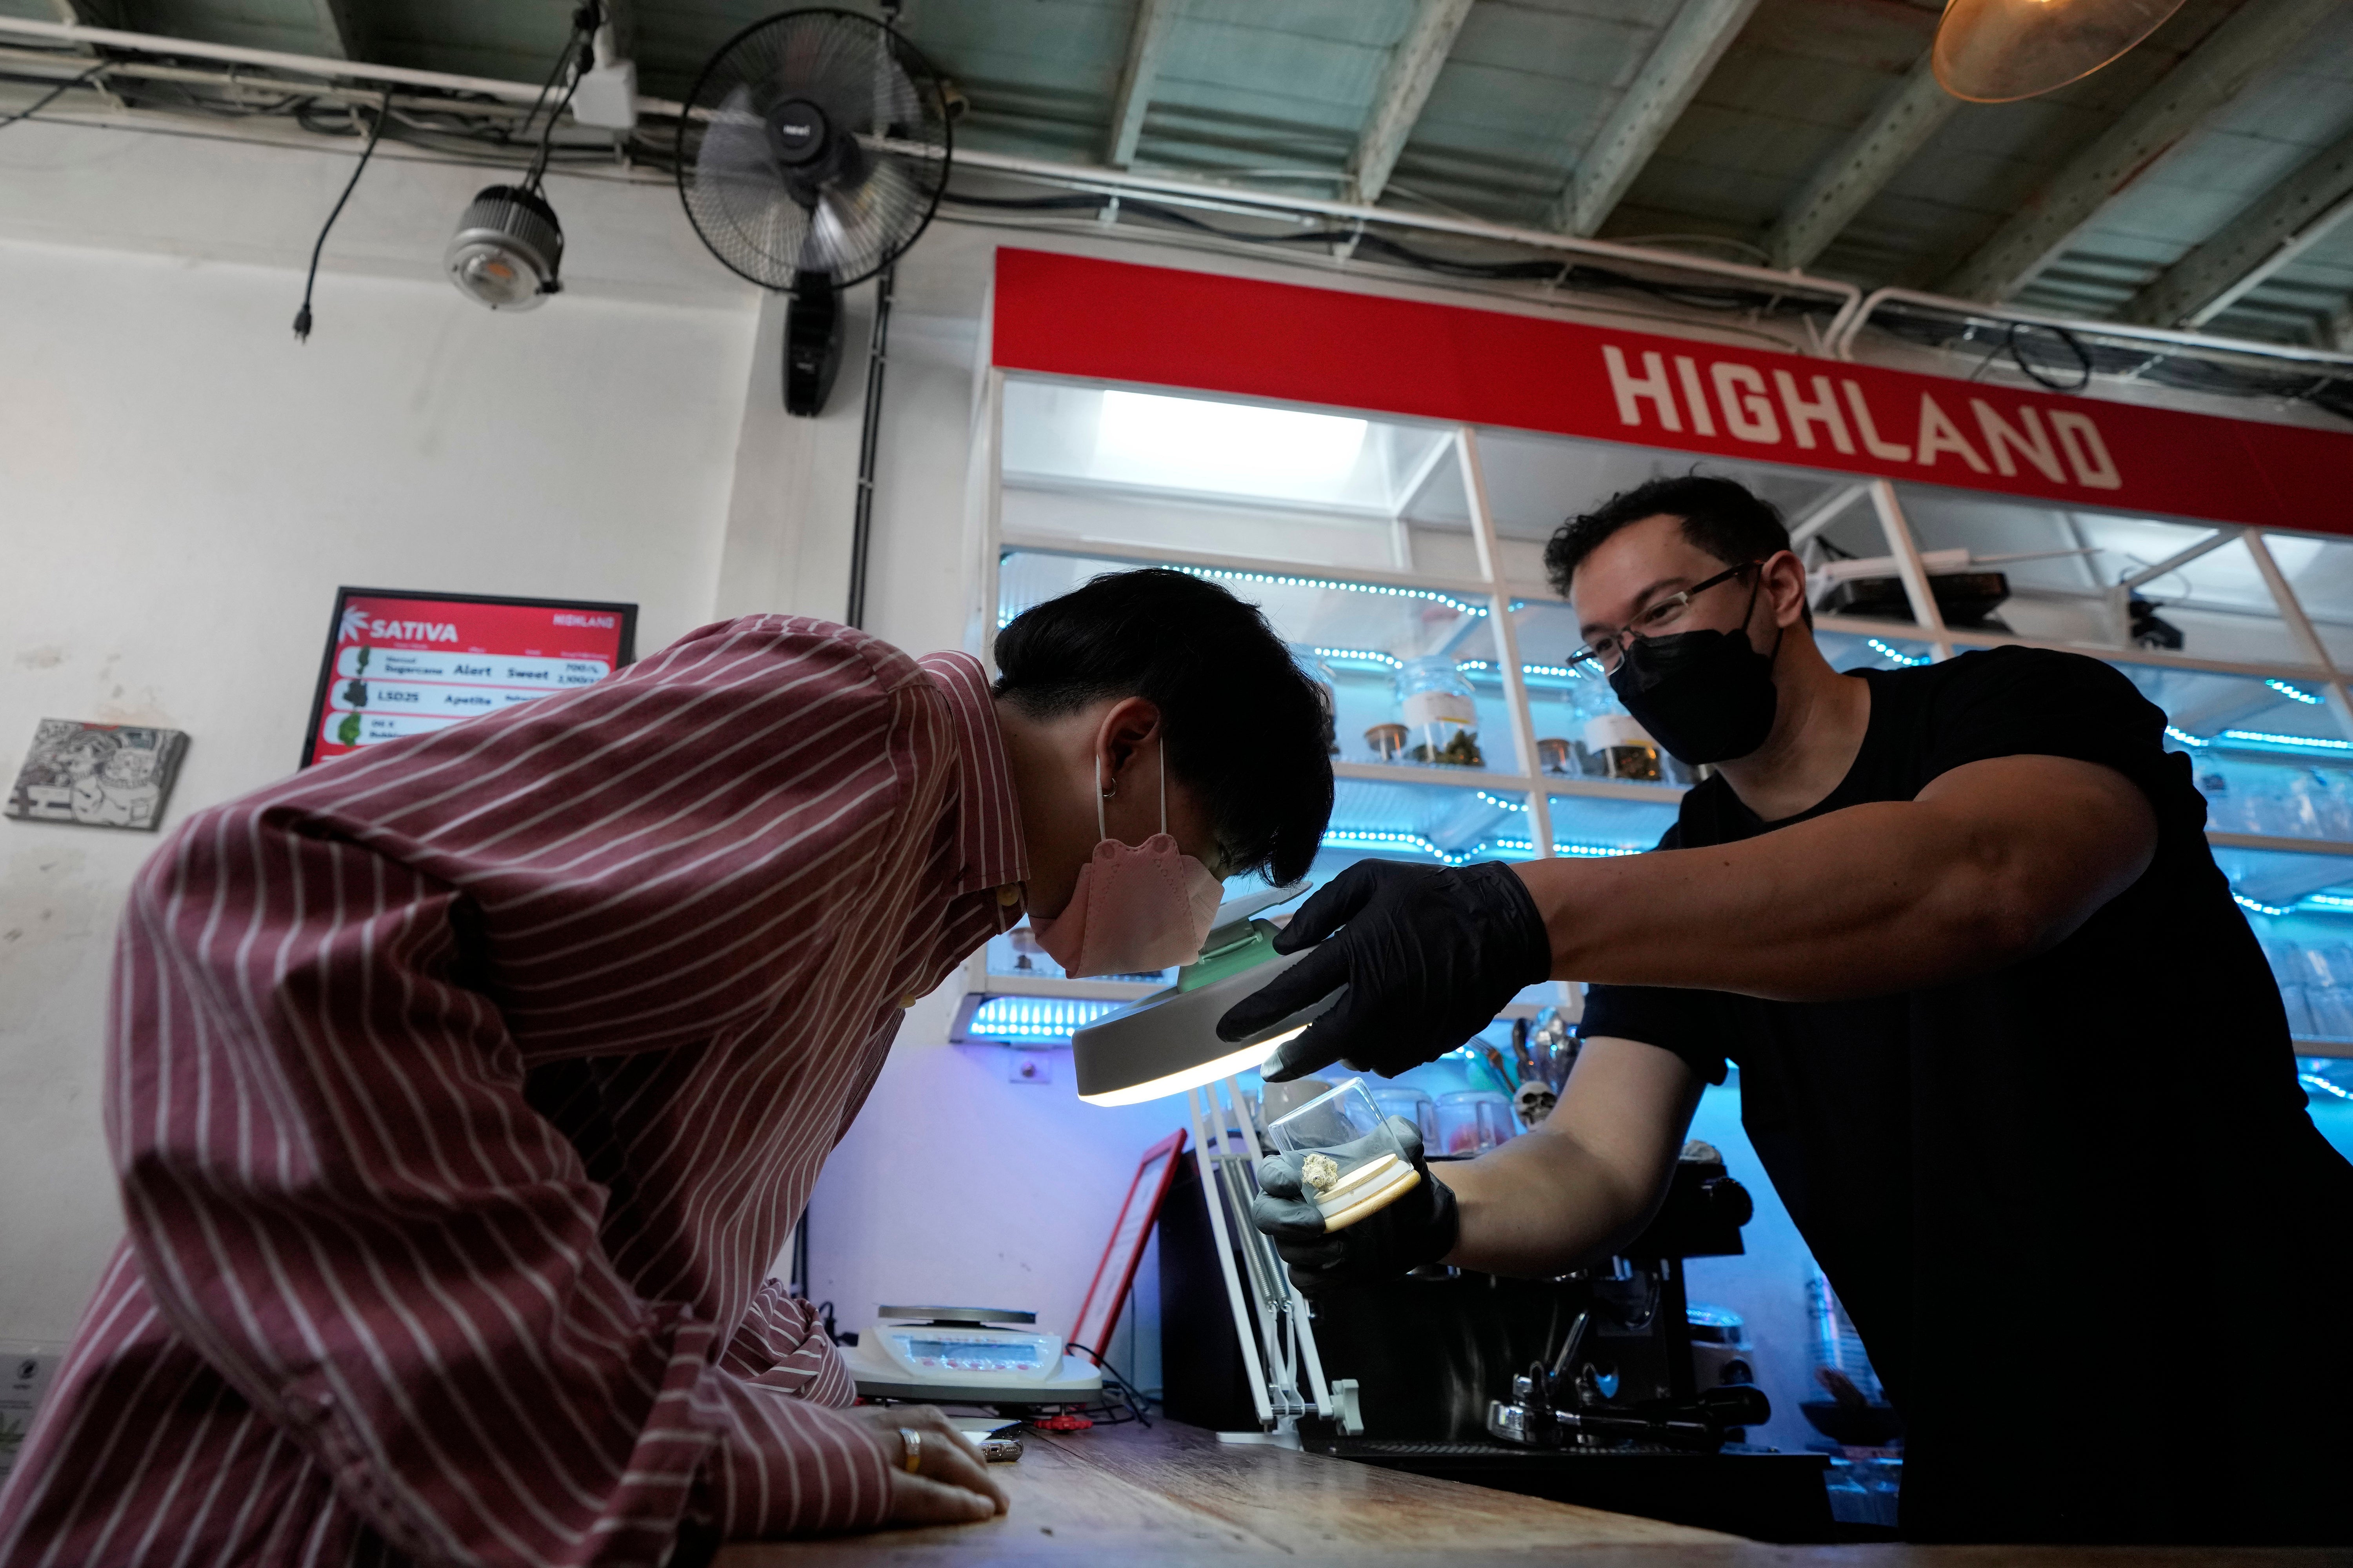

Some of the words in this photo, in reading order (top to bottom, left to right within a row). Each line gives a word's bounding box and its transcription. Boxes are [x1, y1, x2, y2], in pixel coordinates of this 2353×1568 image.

[1601, 343, 2122, 491] HIGHLAND
[553, 614, 615, 629] HIGHLAND
[369, 619, 458, 642] SATIVA
[453, 664, 491, 676] Alert
[507, 667, 548, 680] Sweet
